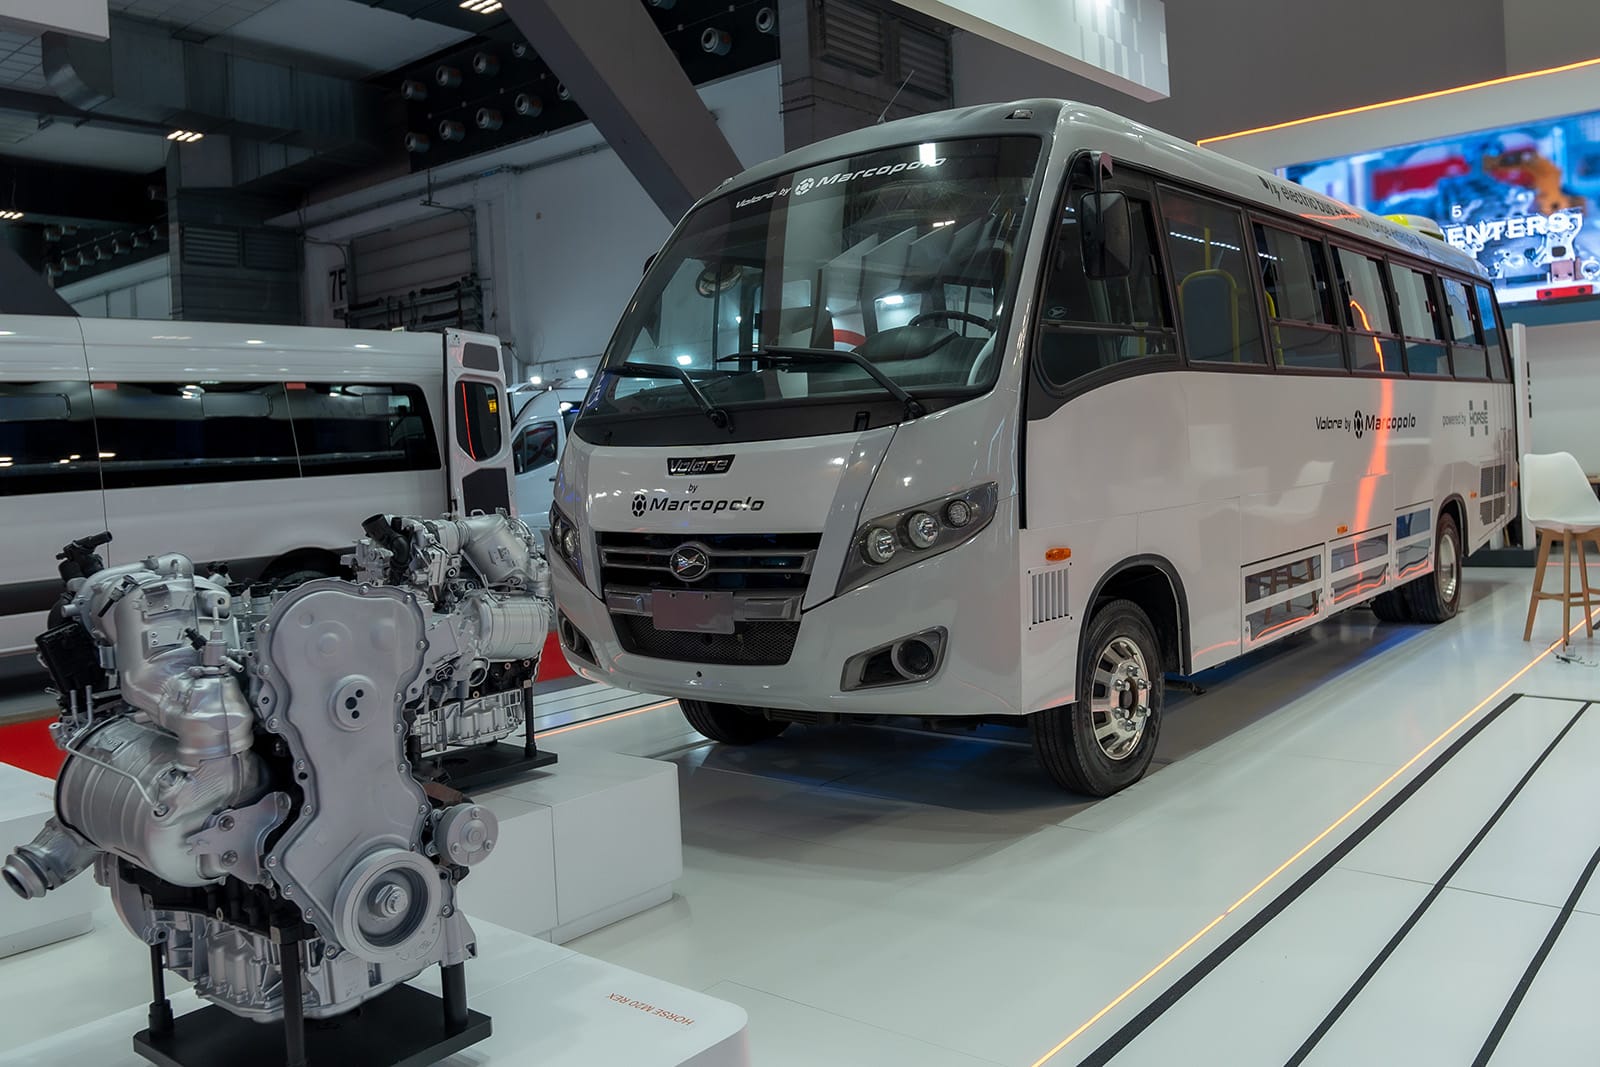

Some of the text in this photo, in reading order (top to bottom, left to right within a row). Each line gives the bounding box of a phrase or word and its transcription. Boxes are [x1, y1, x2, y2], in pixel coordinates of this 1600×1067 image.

[1451, 205, 1462, 218] 5
[1440, 212, 1570, 247] ENTERS
[1315, 415, 1343, 430] Volare
[1344, 416, 1352, 432] by
[669, 457, 730, 473] Volare
[688, 483, 698, 494] by
[649, 496, 765, 514] Marcopolo
[628, 1001, 655, 1012] M20
[651, 1008, 695, 1025] HORSE
